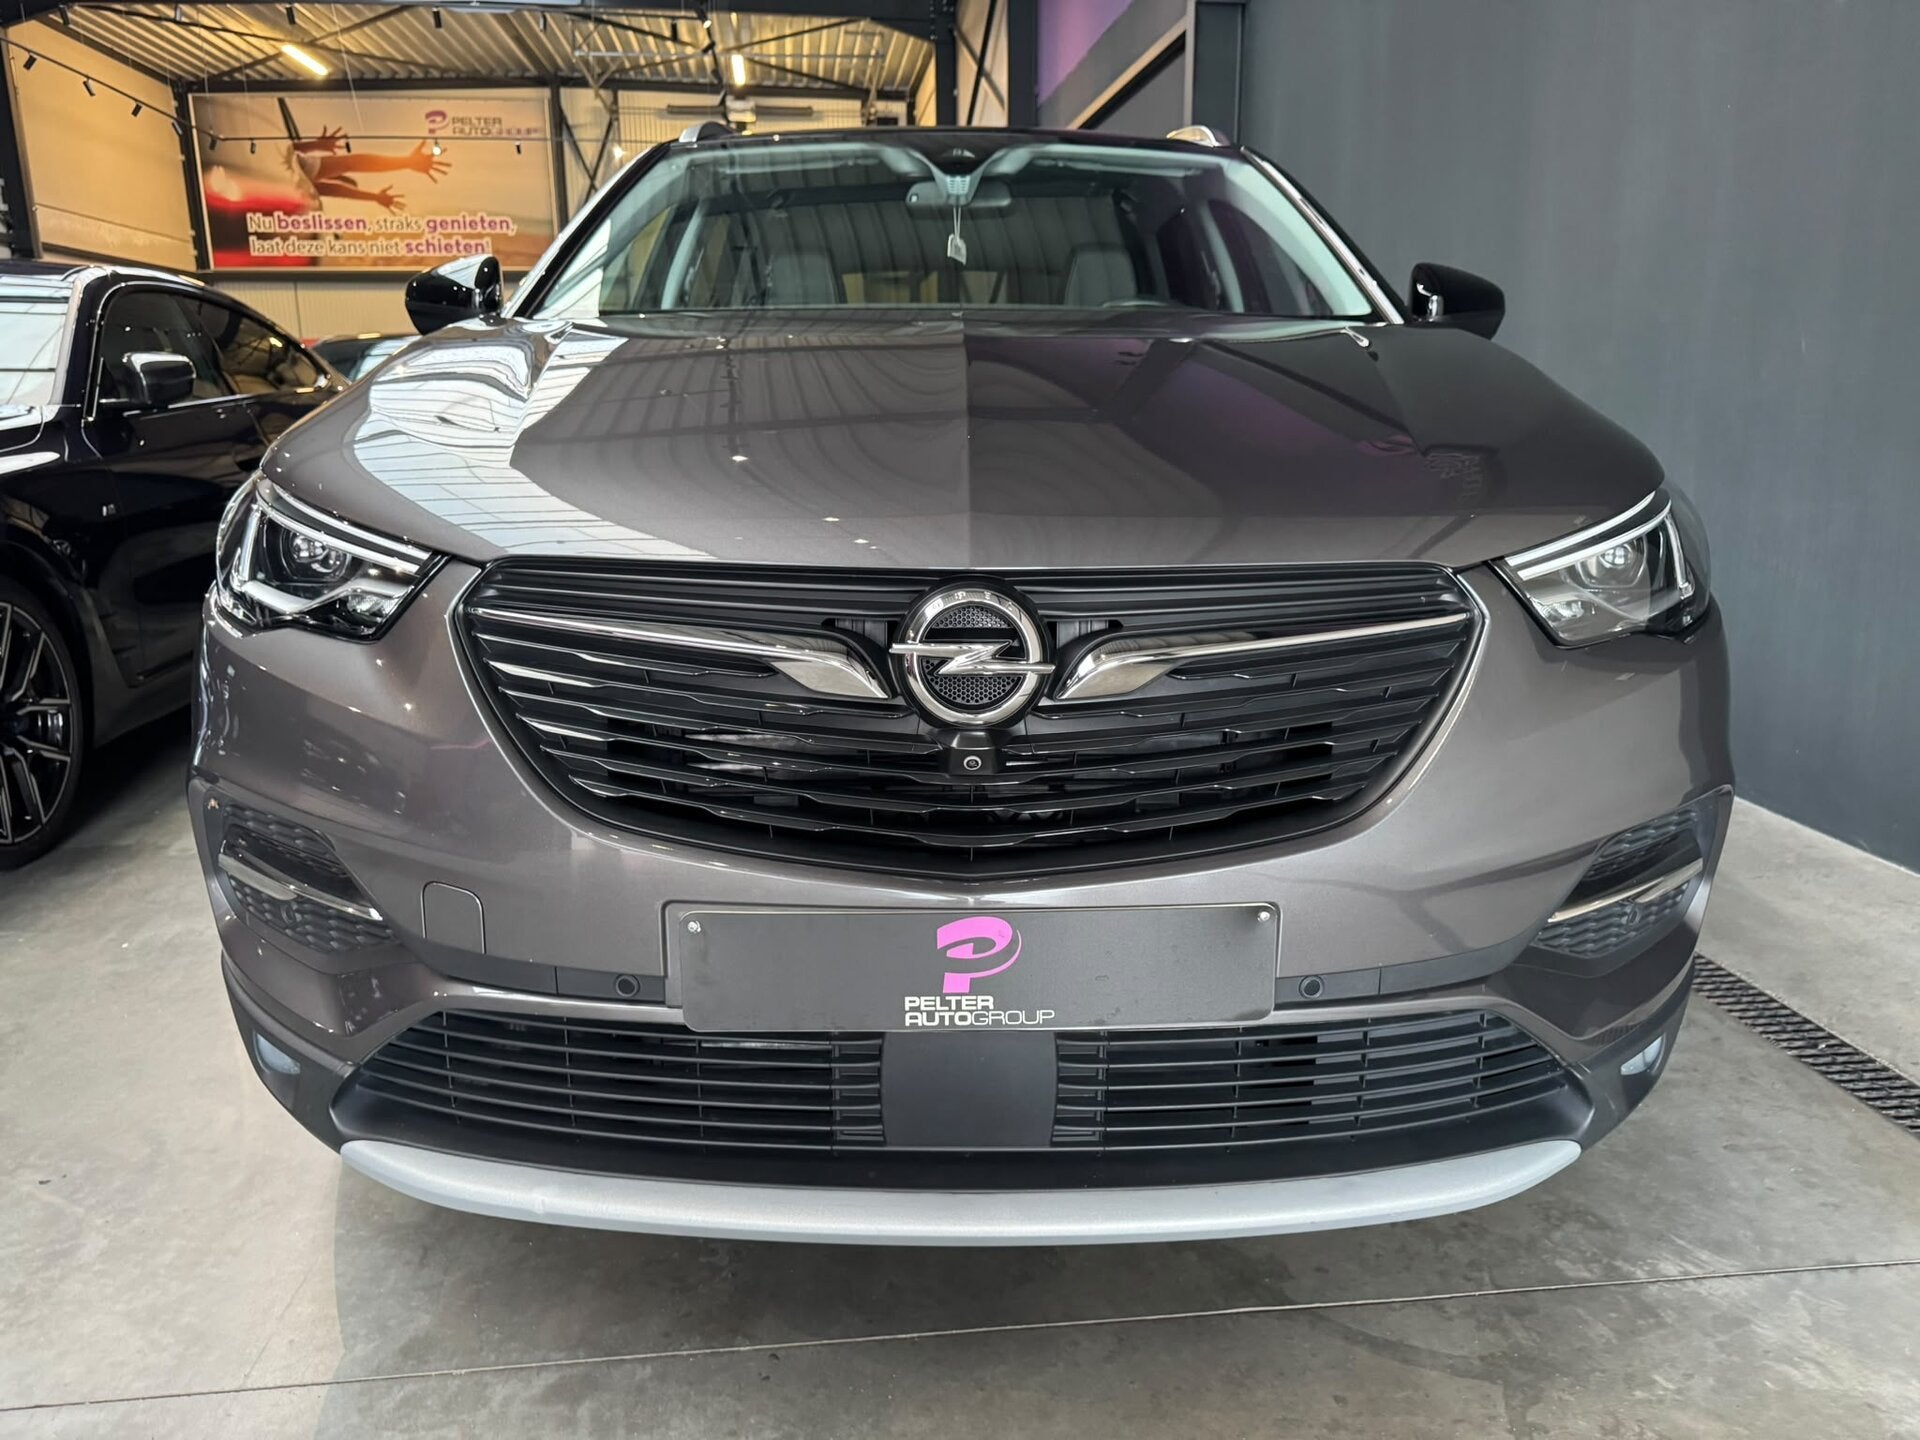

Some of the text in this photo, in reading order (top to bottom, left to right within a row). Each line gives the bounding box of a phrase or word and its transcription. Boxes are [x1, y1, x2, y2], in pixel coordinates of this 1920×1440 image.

[452, 116, 502, 126] PELTER
[247, 213, 516, 234] Nu beslissen, straks genieten,
[250, 237, 490, 255] laat deze kans niet schieten!
[904, 995, 994, 1011] PELTER
[904, 1009, 1055, 1026] AUTOGROUP
